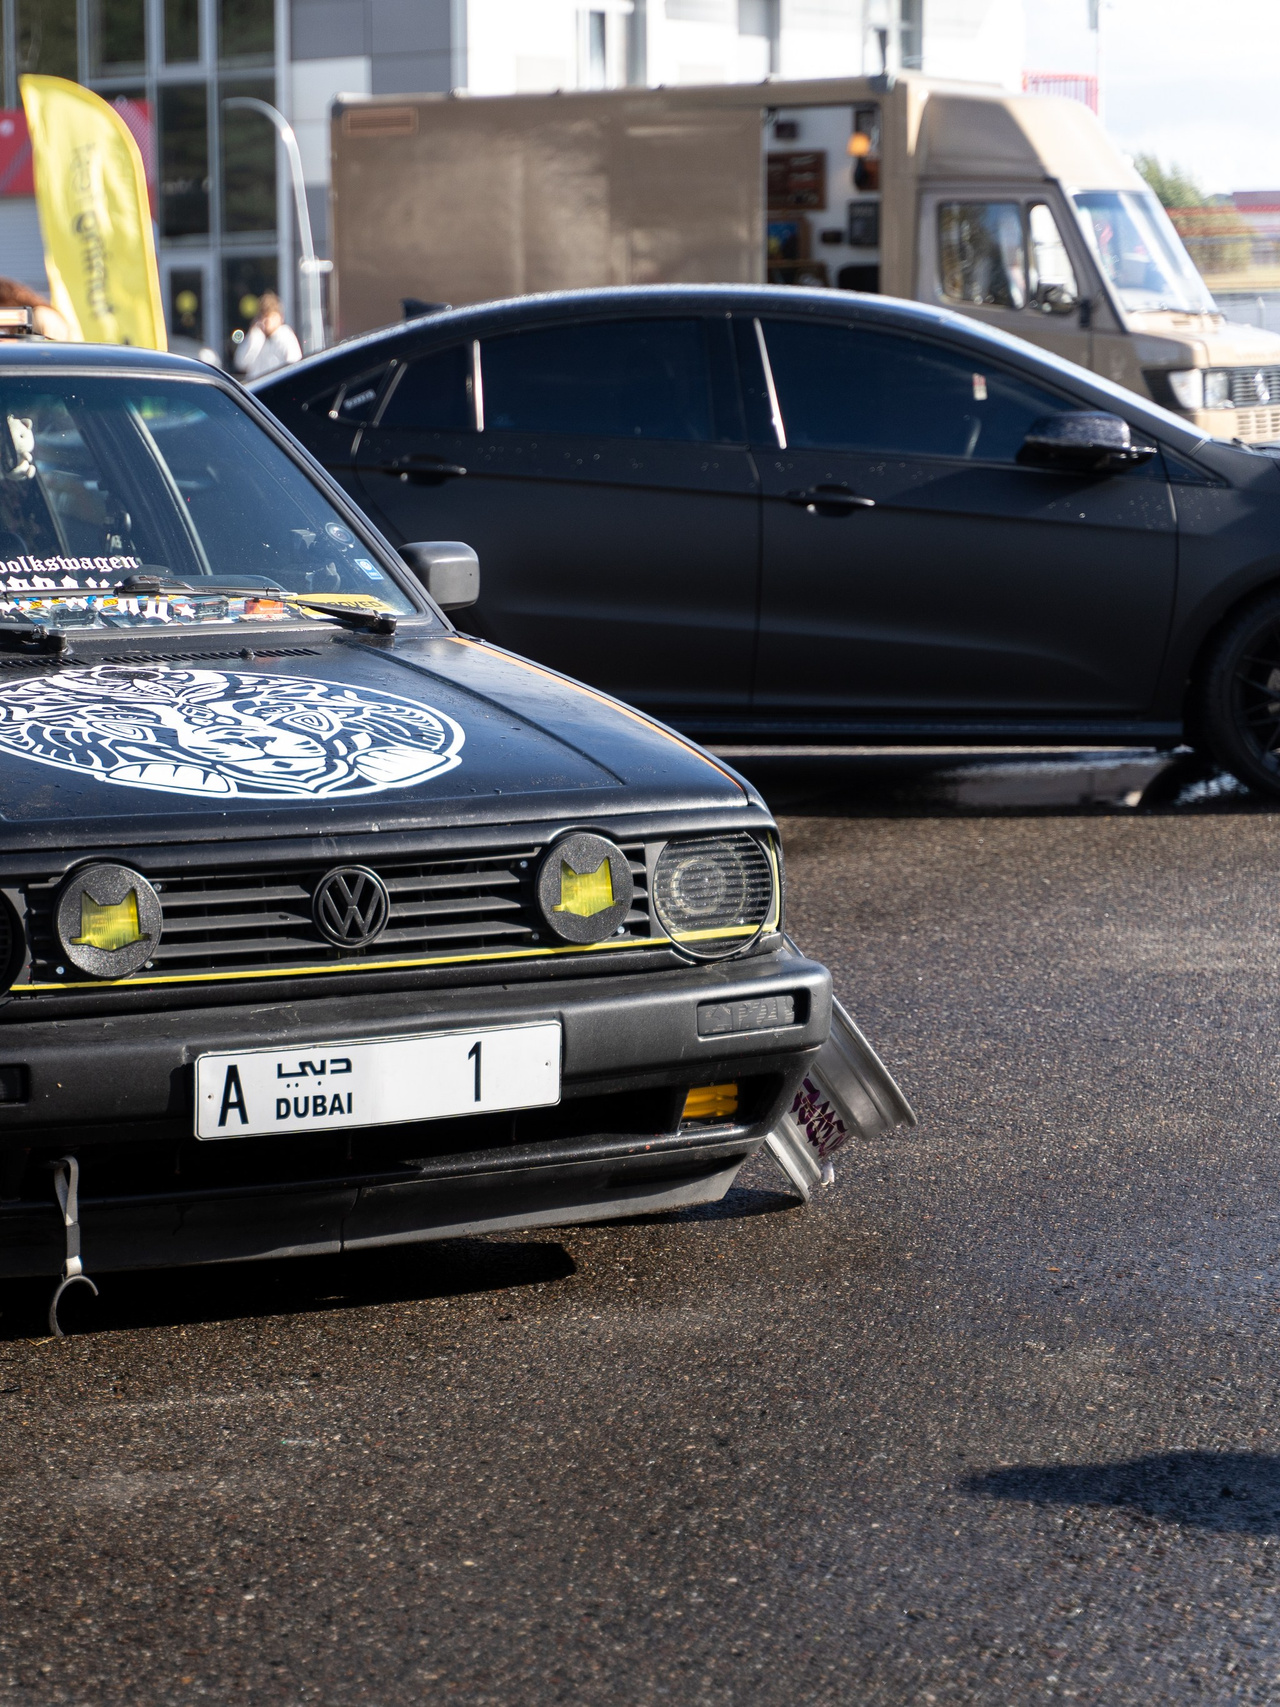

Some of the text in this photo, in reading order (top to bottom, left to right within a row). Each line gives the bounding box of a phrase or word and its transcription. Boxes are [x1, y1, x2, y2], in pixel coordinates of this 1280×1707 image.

[276, 1057, 352, 1088] دبي
[467, 1040, 483, 1103] 1
[217, 1064, 249, 1128] A
[275, 1091, 353, 1121] DUBAI
